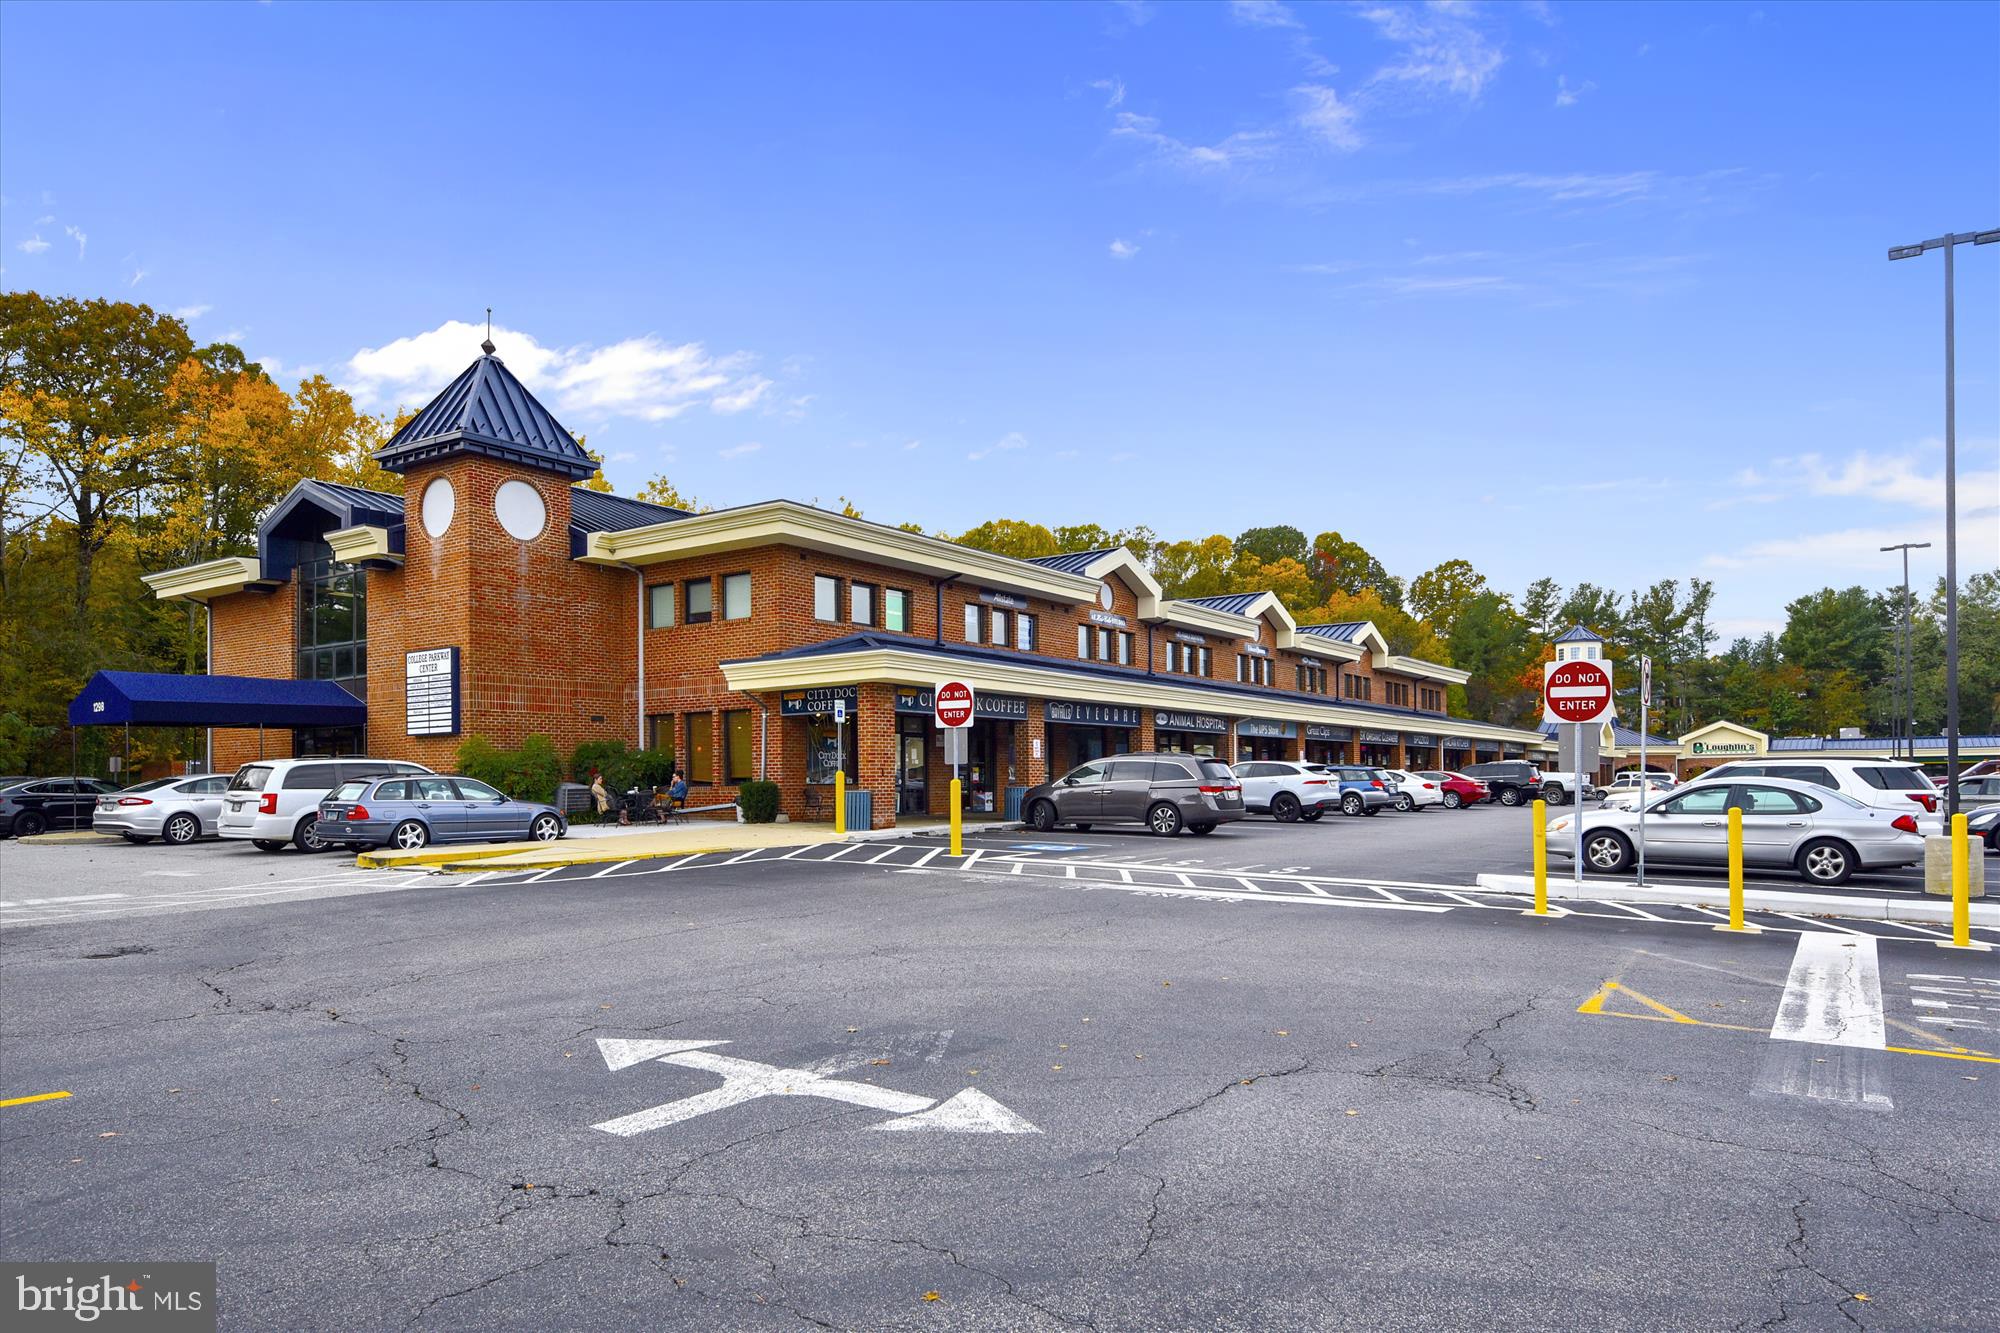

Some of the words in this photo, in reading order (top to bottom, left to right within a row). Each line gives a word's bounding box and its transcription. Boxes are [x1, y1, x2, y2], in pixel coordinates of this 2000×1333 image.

[407, 653, 428, 664] COLLEGE
[428, 651, 450, 662] PARKWAY
[419, 663, 438, 673] CENTER
[1555, 674, 1571, 684] DO
[1578, 673, 1601, 683] NOT
[807, 688, 832, 700] CITY
[834, 687, 857, 698] DOC
[941, 691, 950, 699] DO
[954, 690, 967, 698] NOT
[985, 698, 1025, 714] COFFEE
[1559, 700, 1596, 711] ENTER
[943, 710, 965, 719] ENTER
[1076, 705, 1137, 723] EYECARE
[1169, 714, 1195, 728] ANIMAL
[1196, 715, 1226, 730] HOSPITAL
[1250, 724, 1258, 735] The
[1258, 725, 1267, 736] UPS
[1268, 725, 1279, 736] Store
[1306, 726, 1319, 737] Great
[1319, 726, 1331, 739] Clips
